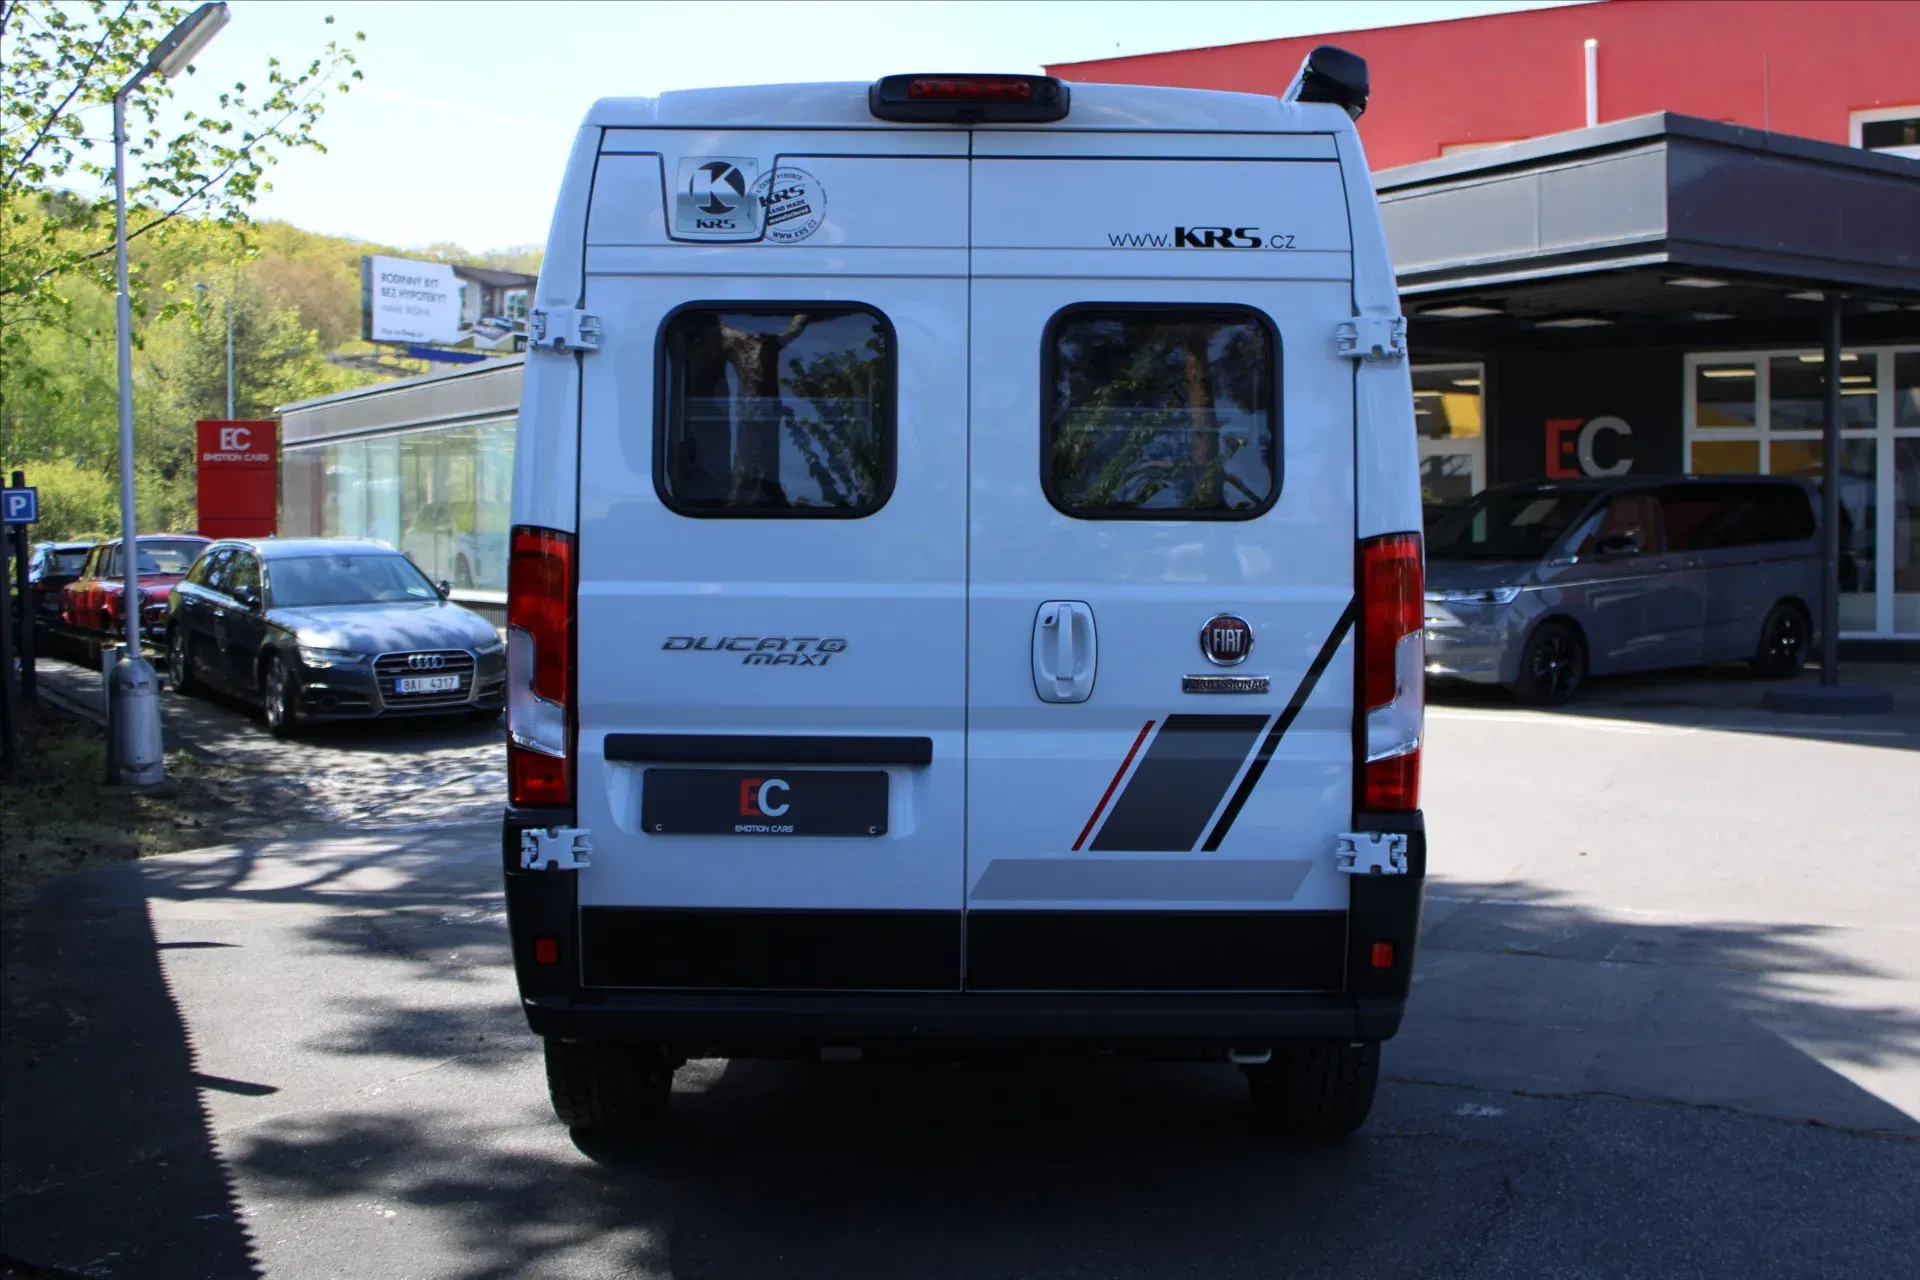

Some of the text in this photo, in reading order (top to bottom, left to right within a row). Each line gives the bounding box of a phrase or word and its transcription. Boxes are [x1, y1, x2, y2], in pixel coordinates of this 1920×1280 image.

[696, 218, 736, 229] KRS
[1107, 227, 1296, 249] www.KRS.cz
[380, 287, 397, 298] BEZ
[220, 427, 251, 451] EC
[1545, 416, 1633, 478] EC
[10, 496, 26, 516] P
[661, 636, 849, 652] DUCATO
[1213, 629, 1244, 652] FIAT
[742, 653, 832, 666] MAXI
[429, 677, 455, 689] 4317
[739, 778, 791, 817] EC
[735, 824, 793, 833] EMOTION CARS
